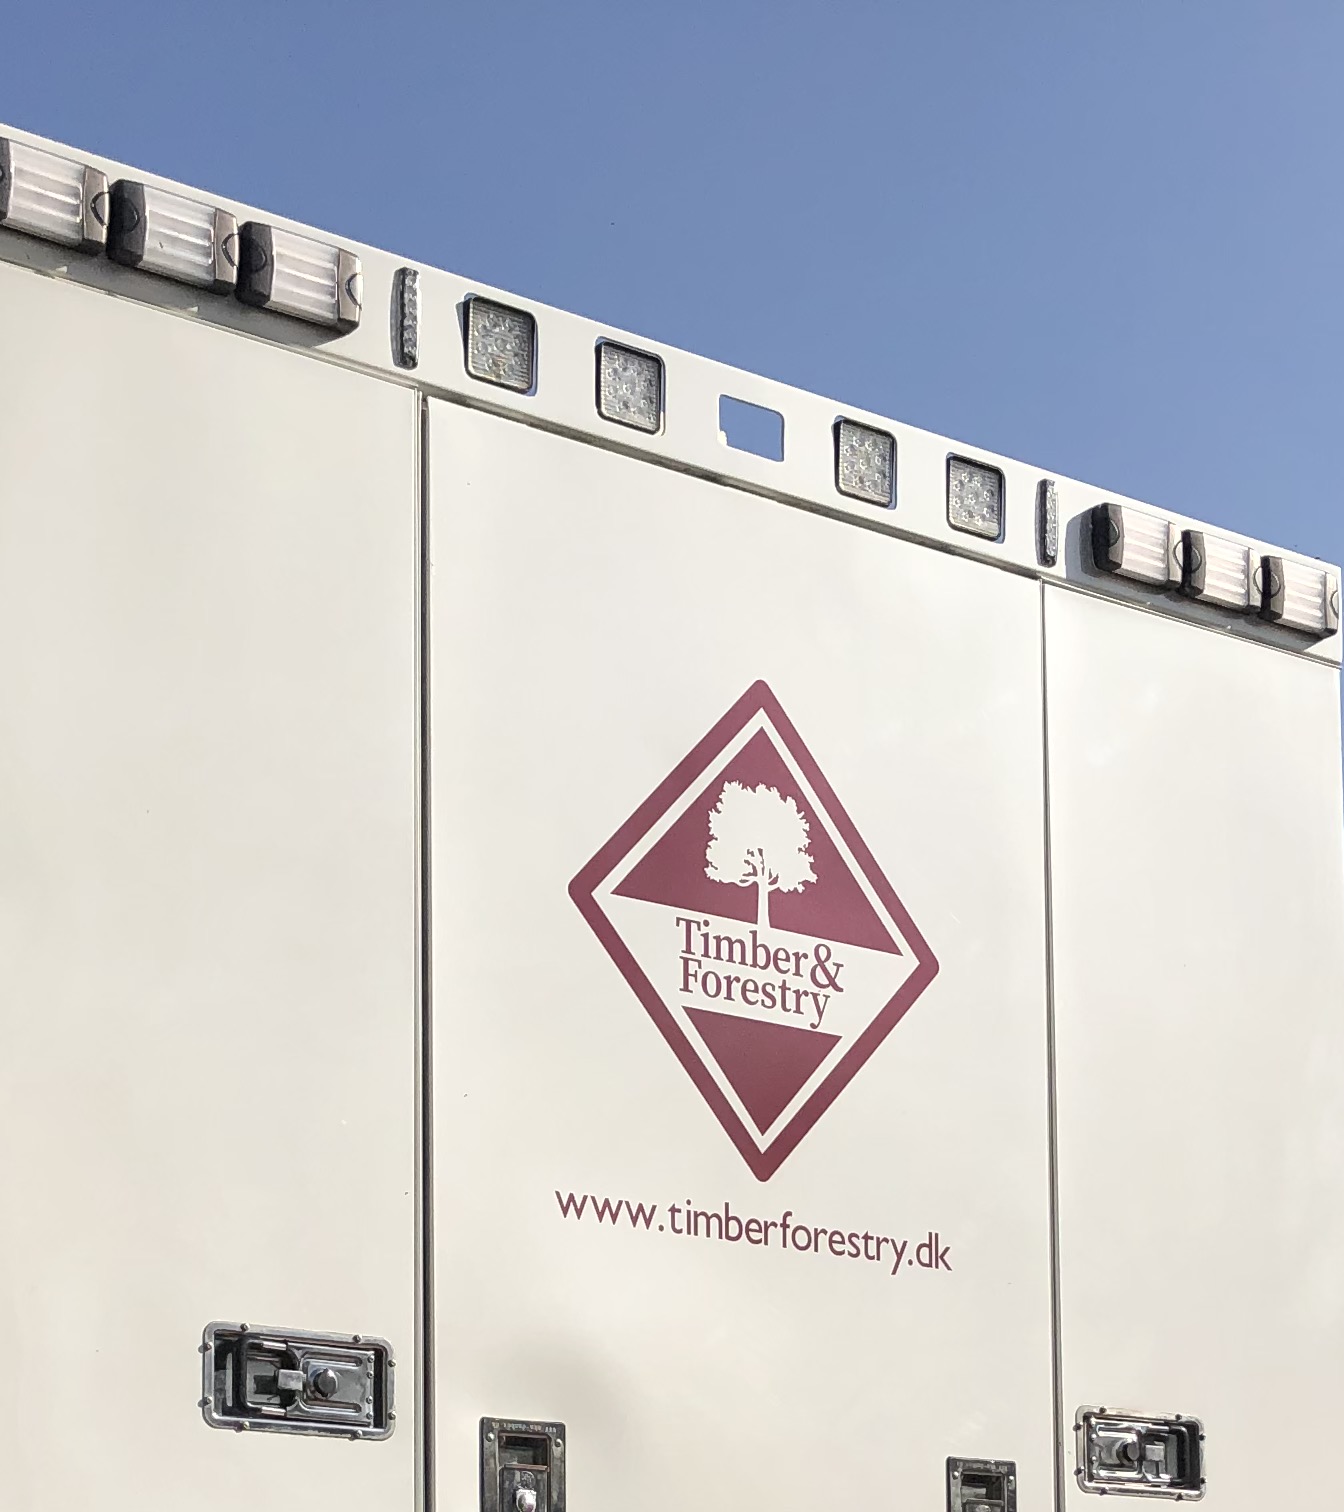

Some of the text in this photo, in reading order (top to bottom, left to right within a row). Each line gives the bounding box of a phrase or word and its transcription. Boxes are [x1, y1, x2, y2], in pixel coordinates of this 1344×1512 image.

[676, 916, 844, 993] Timber&
[679, 956, 831, 1029] Forestry
[555, 1190, 953, 1275] www.timberforestry.dk
